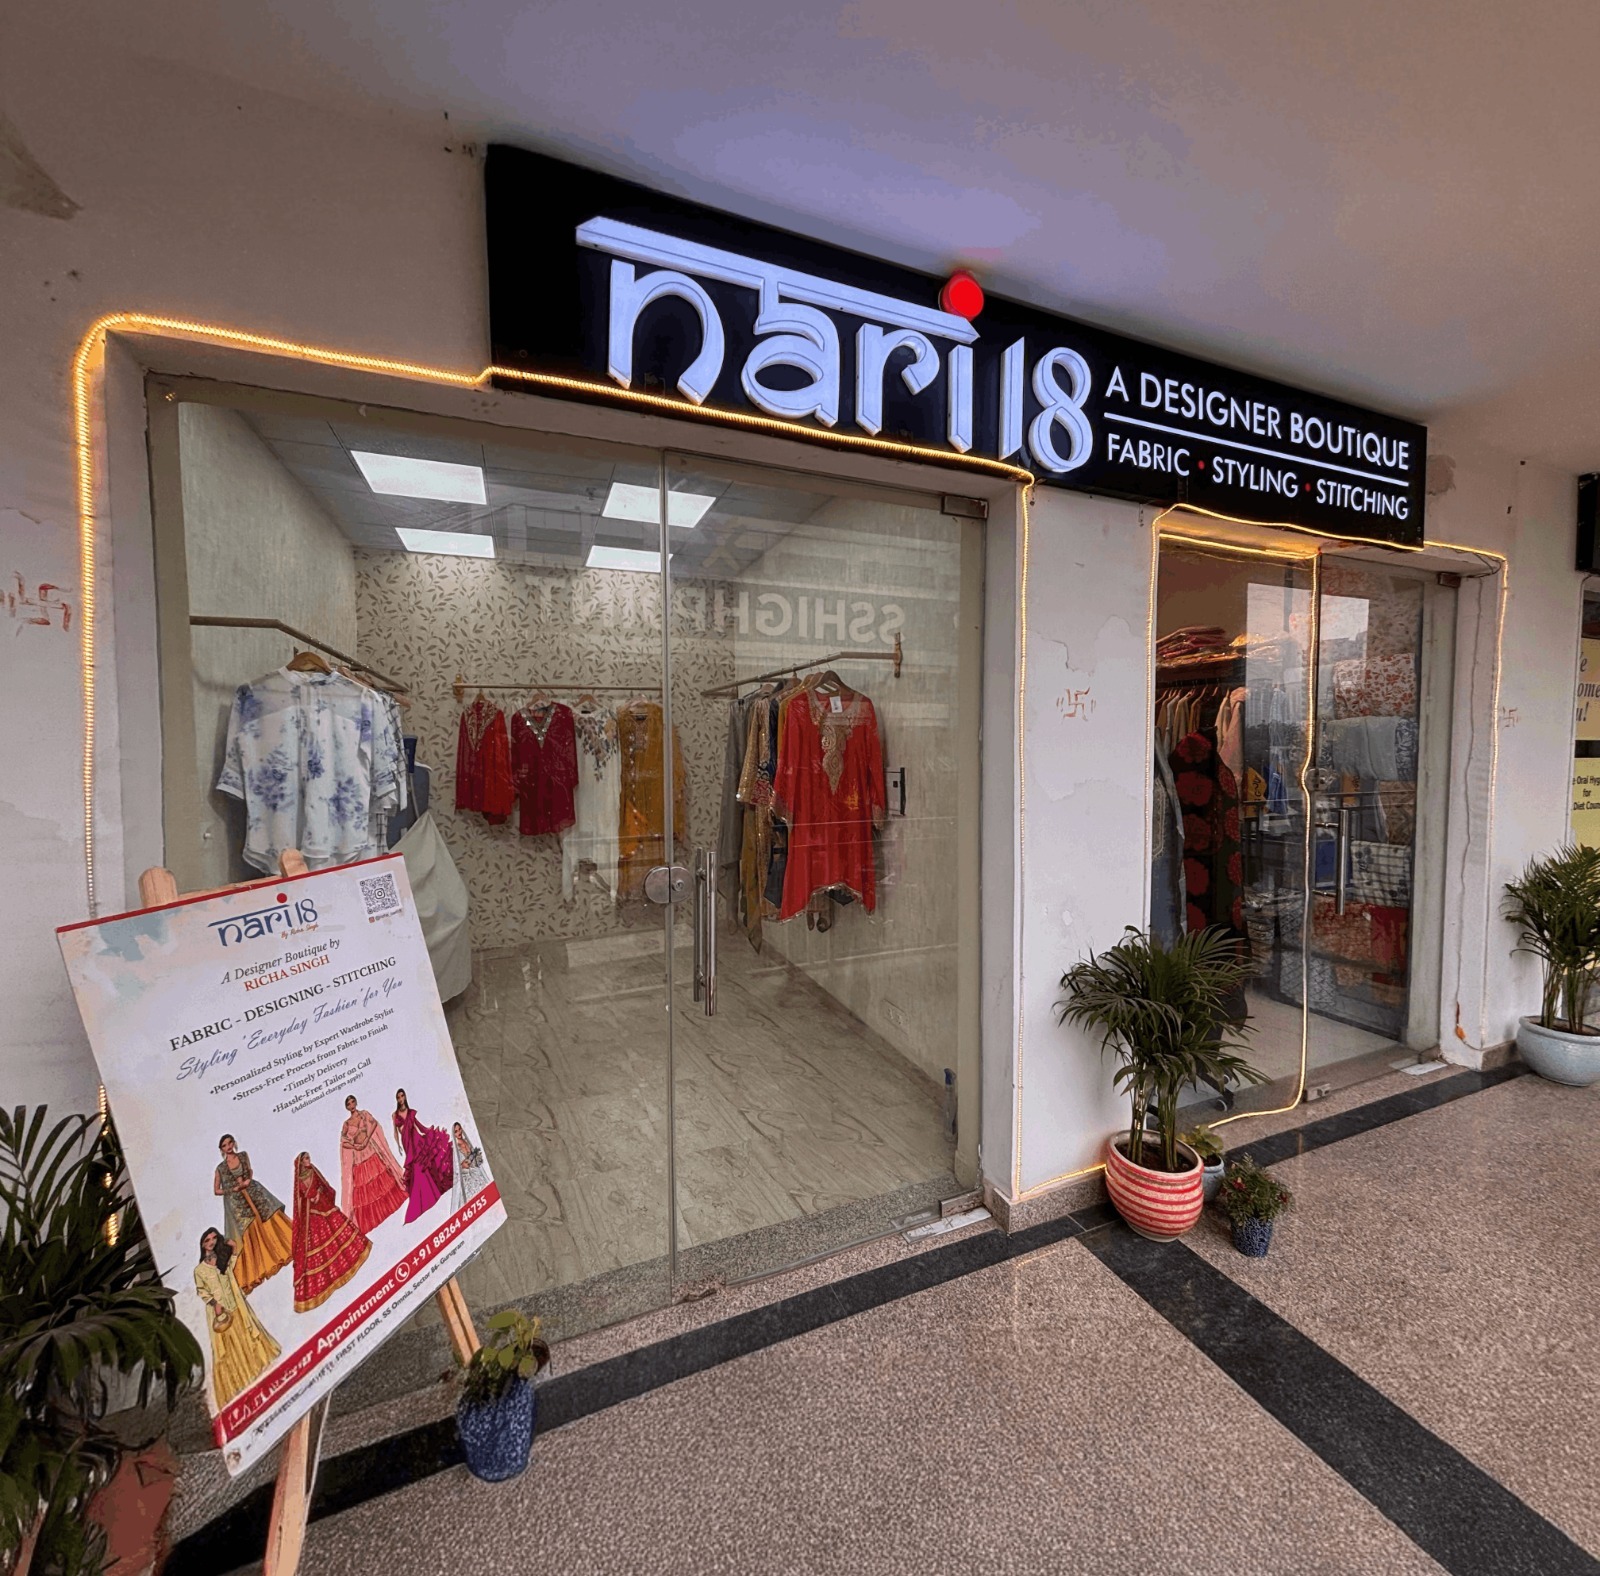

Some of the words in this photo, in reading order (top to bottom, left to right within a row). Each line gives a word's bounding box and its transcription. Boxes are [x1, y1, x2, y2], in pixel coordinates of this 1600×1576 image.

[1105, 366, 1129, 402] A
[1140, 372, 1282, 439] DESIGNER
[1108, 433, 1190, 476] FABRIC
[1212, 456, 1299, 498] STYLING
[1316, 479, 1409, 520] STITCHING
[1586, 801, 1600, 809] Coun
[221, 972, 231, 985] A
[235, 956, 283, 980] Designer
[285, 944, 327, 964] Boutique
[329, 938, 340, 950] by
[244, 968, 289, 992] RICHA
[290, 954, 330, 976] SINGH
[170, 1018, 233, 1051] FABRIC
[244, 983, 324, 1022] DESIGNING
[333, 957, 396, 988] STITCHING
[176, 1047, 238, 1080] Styling
[363, 990, 379, 1008] for
[382, 977, 403, 998] You
[213, 1061, 272, 1095] Personalized
[273, 1046, 304, 1071] Styling
[304, 1042, 314, 1055] by
[314, 1031, 340, 1049] Expert
[340, 1015, 375, 1036] Wardrobe
[374, 1007, 395, 1022] Stylist
[236, 1073, 286, 1101] Stress-Free
[286, 1059, 317, 1077] Process
[317, 1048, 337, 1066] from
[336, 1036, 360, 1053] Fabric
[360, 1033, 368, 1042] to
[367, 1023, 389, 1039] Finish
[317, 1056, 349, 1078] Delivery
[323, 1072, 347, 1088] Tailor
[347, 1066, 356, 1076] on
[357, 1057, 372, 1071] Call
[317, 1279, 395, 1354] Appointment
[412, 1245, 432, 1267] +91
[432, 1218, 461, 1248] 88264
[462, 1195, 487, 1223] 46755
[382, 1307, 392, 1318] SS
[413, 1271, 431, 1290] Sector
